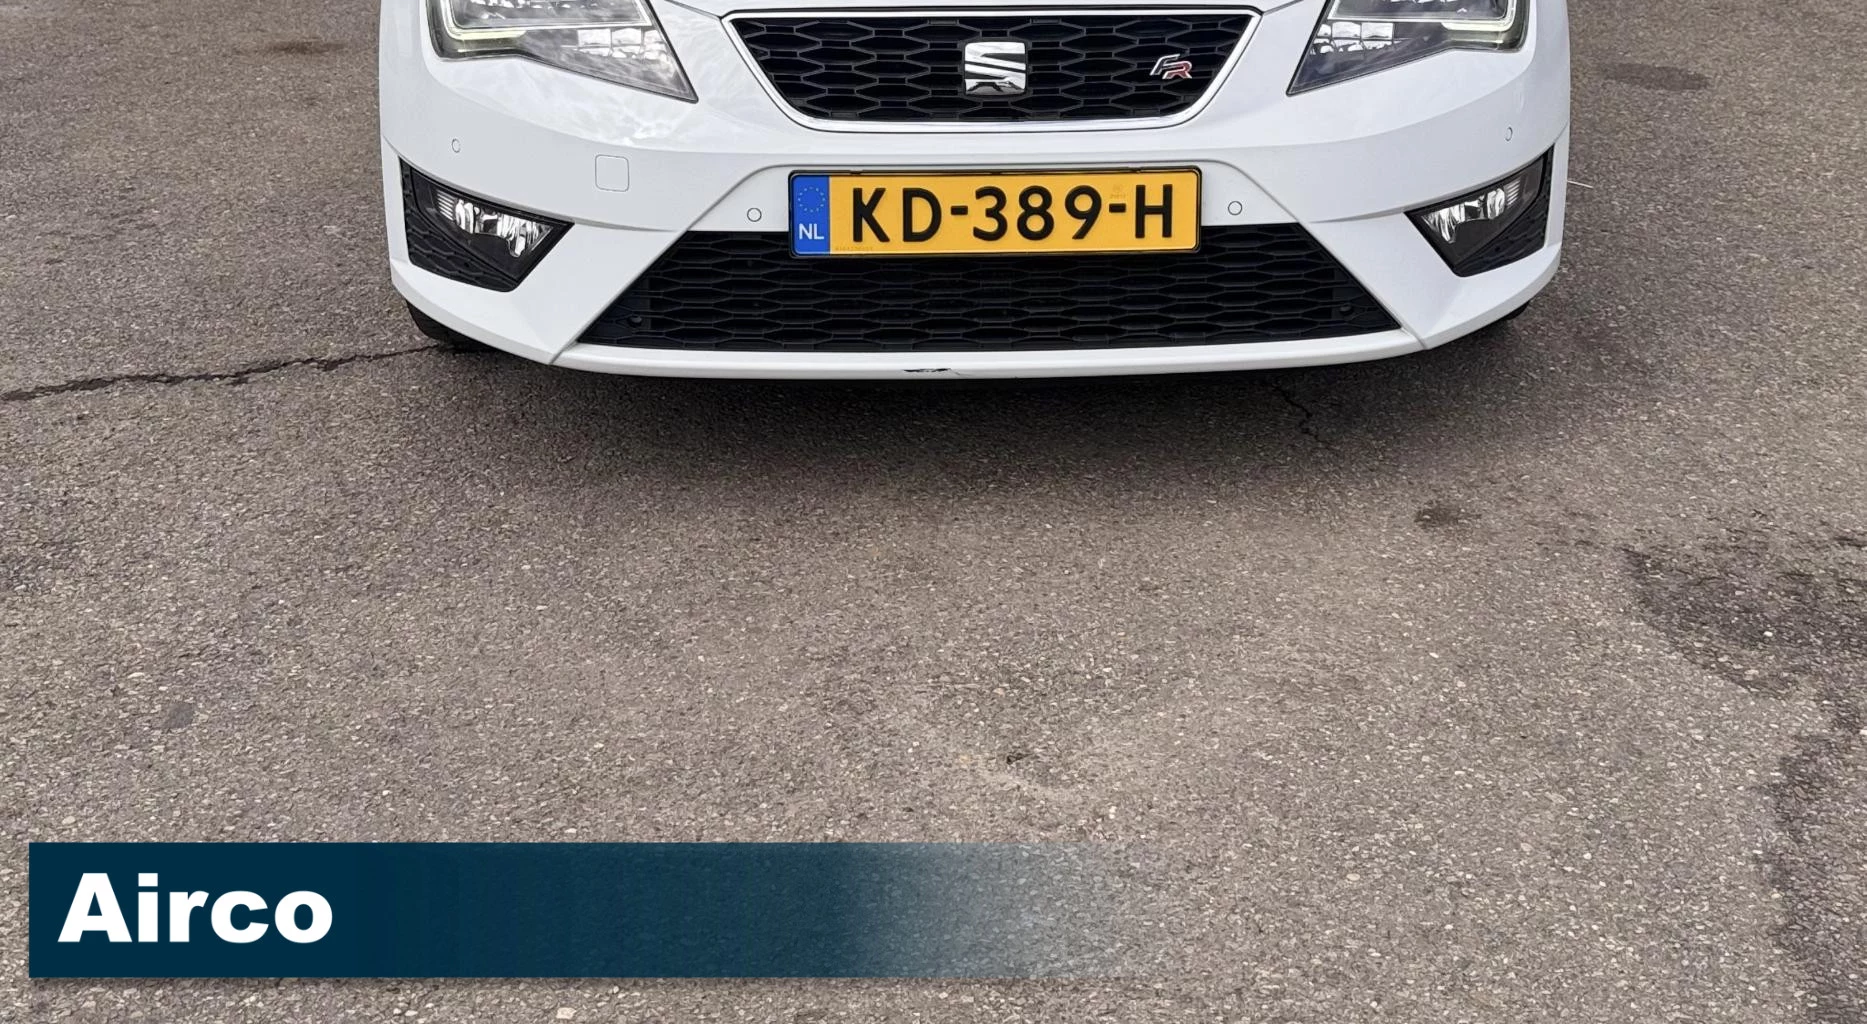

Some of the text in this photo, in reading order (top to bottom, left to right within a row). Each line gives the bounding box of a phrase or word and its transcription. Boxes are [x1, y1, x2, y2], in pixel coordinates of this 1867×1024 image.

[1149, 53, 1193, 80] FR
[852, 183, 1173, 243] KD-389-H
[798, 223, 825, 241] NL
